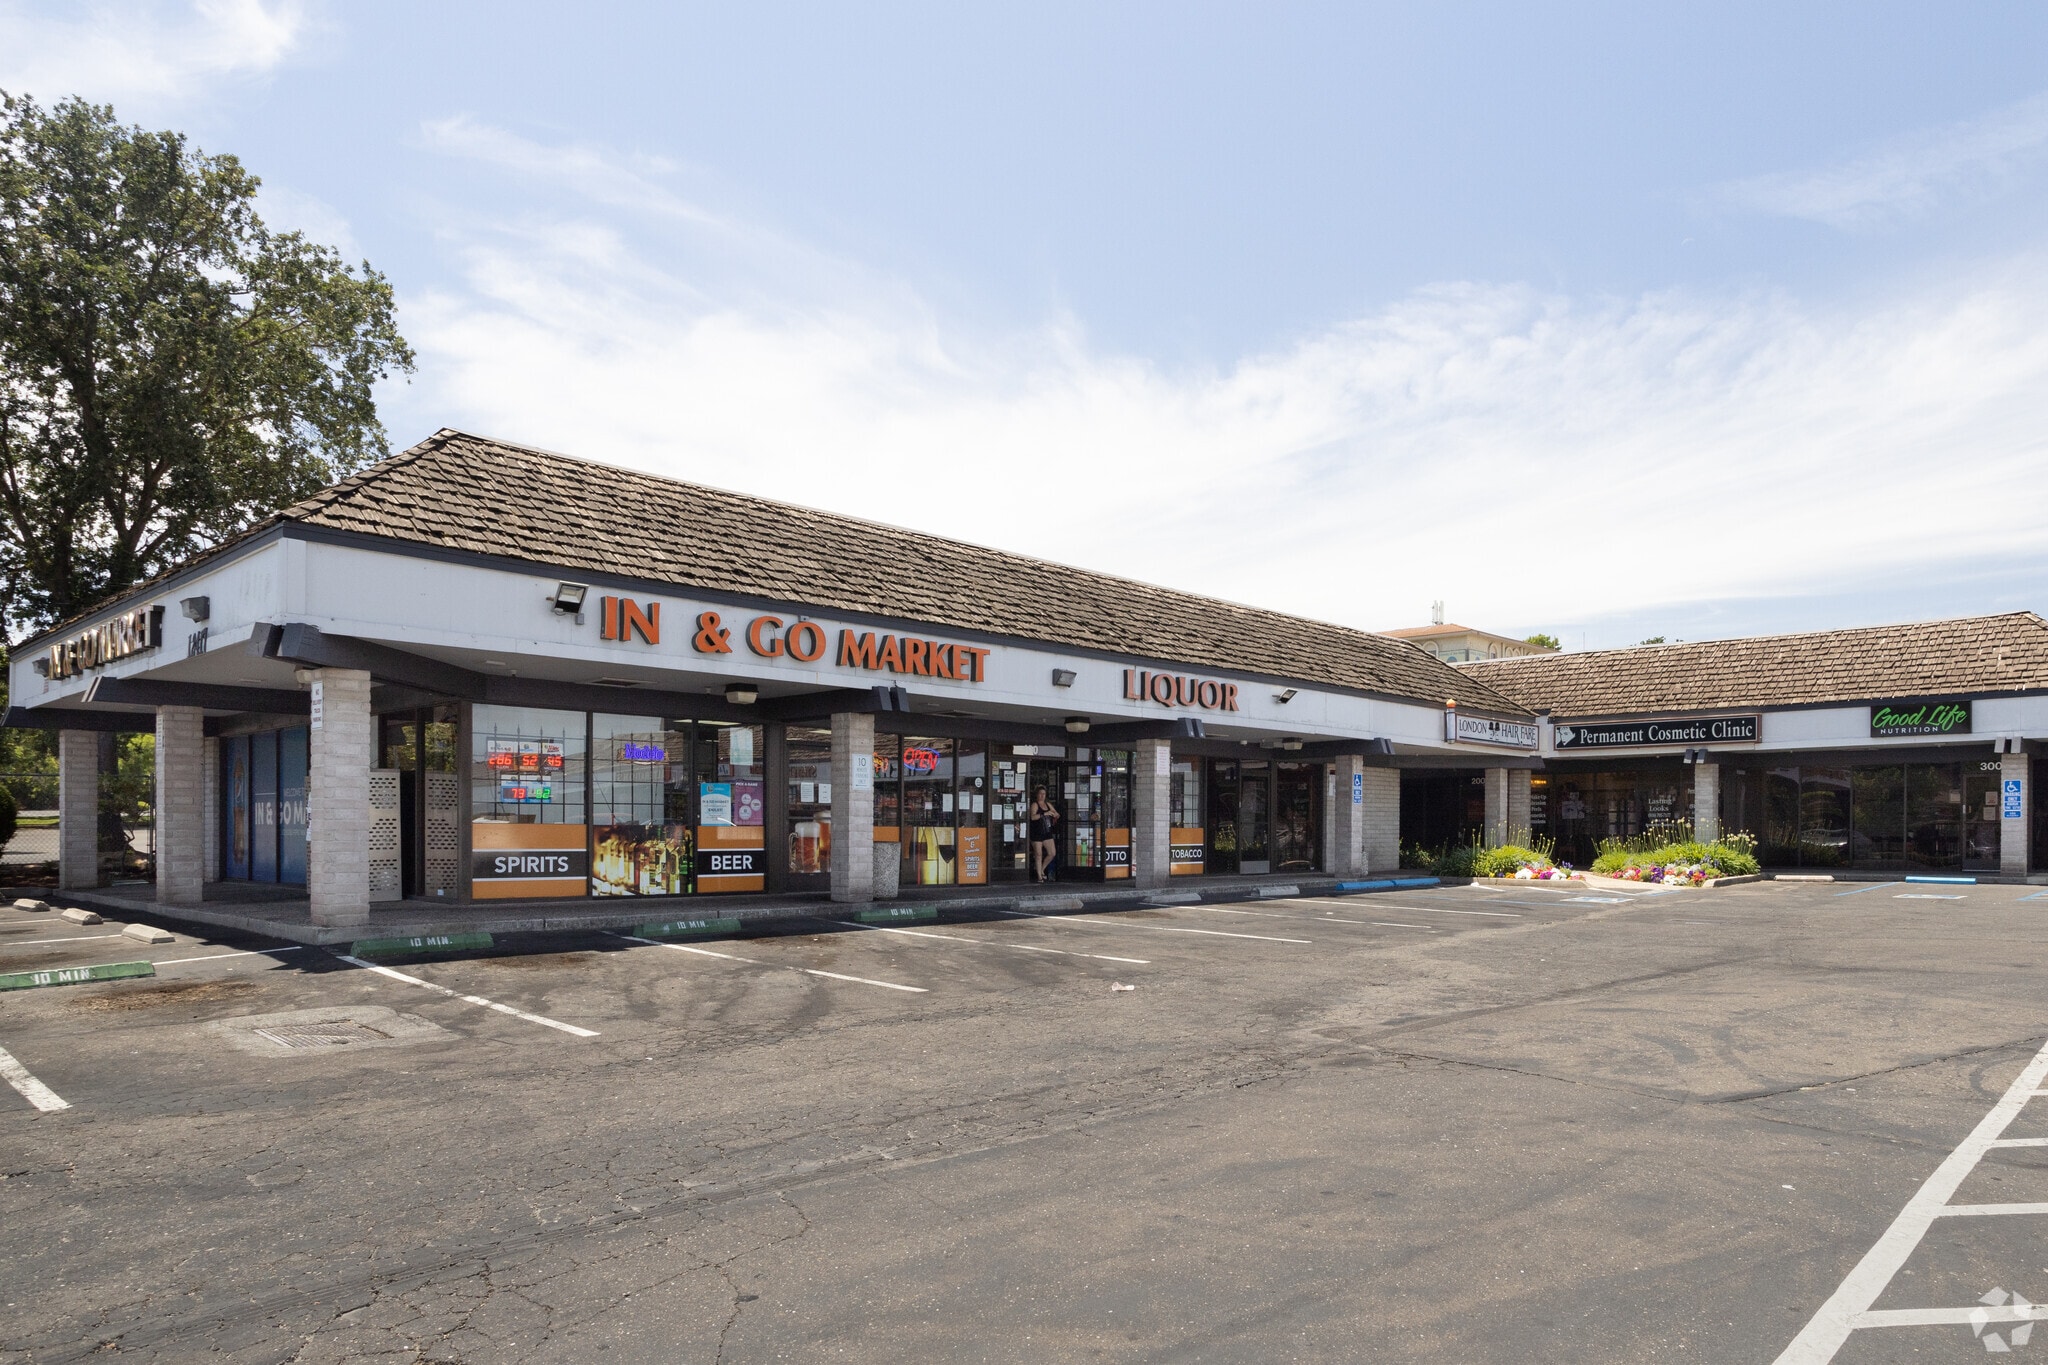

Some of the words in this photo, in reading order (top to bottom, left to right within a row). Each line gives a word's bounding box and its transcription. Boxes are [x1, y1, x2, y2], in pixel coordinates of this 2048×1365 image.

[600, 595, 661, 645] IN
[691, 611, 733, 654] &
[745, 615, 827, 662] GO
[836, 628, 991, 683] MARKET
[1123, 668, 1241, 712] LIQUOR
[1872, 705, 1927, 729] Good
[1925, 704, 1968, 732] Life
[1459, 719, 1487, 734] LONDON
[1501, 724, 1520, 742] HAIR
[1520, 725, 1537, 744] FARE
[1580, 728, 1644, 744] Permanent
[1648, 722, 1707, 742] Cosmetic
[1711, 720, 1753, 738] Clinic
[1880, 726, 1939, 735] NUTRITION
[522, 755, 538, 766] 52
[858, 757, 866, 767] 10
[904, 747, 939, 771] OPEN
[1980, 761, 2002, 771] 300
[1471, 777, 1485, 785] 200
[254, 801, 264, 825] IN
[266, 802, 274, 825] &
[1171, 848, 1203, 859] TOBACCO
[494, 855, 569, 874] SPIRITS
[711, 855, 753, 871] BEER
[676, 921, 686, 930] 10
[410, 937, 422, 947] 10
[30, 972, 51, 985] 10
